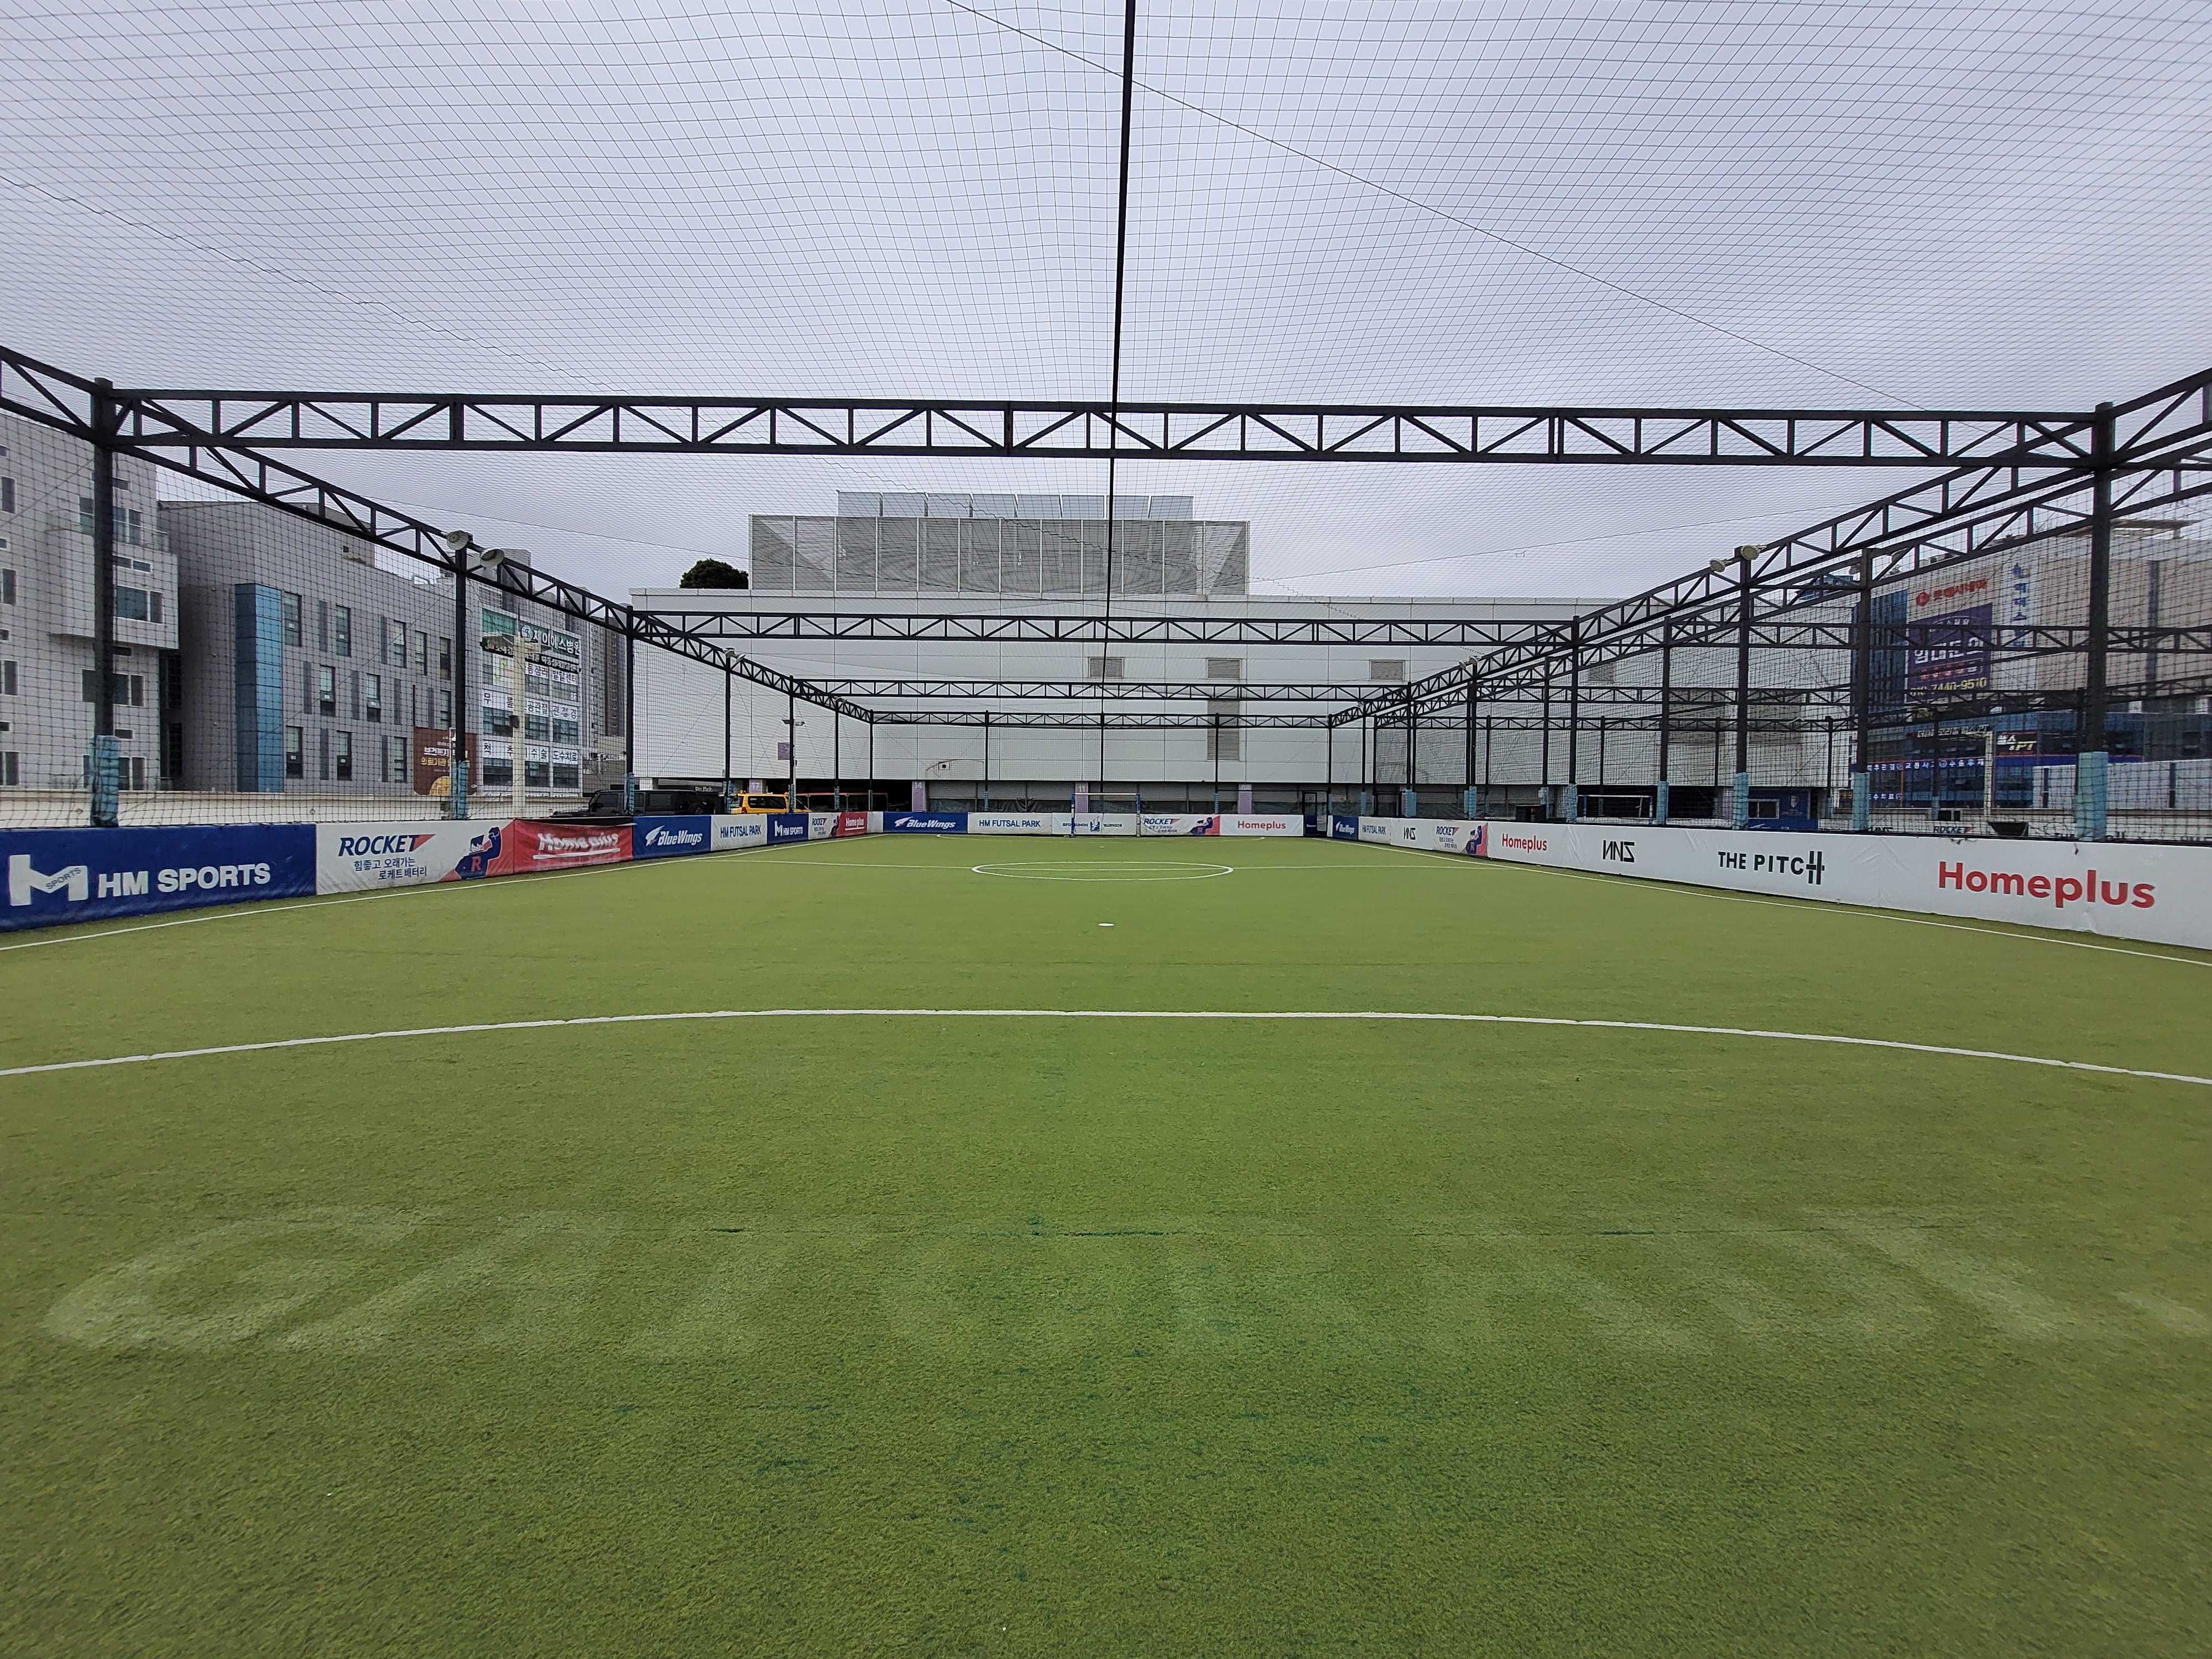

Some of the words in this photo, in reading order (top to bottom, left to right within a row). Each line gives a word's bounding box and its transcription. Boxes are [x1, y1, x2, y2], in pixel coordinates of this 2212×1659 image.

[721, 826, 729, 838] HM
[730, 826, 748, 837] FUTSAL
[749, 825, 761, 835] PARK
[1238, 821, 1286, 831] Homeplus
[1436, 826, 1455, 836] ROCKET
[338, 834, 420, 857] ROCKET
[1502, 833, 1547, 854] Homeplus
[354, 859, 381, 872] 힘좋고
[384, 857, 415, 869] 오래가는
[378, 869, 403, 880] 로케트
[404, 867, 427, 878] 배터리
[1718, 851, 1746, 870] THE
[1754, 851, 1825, 885] PITCH
[46, 868, 82, 889] SPORTS
[98, 871, 149, 898] HM
[158, 863, 271, 893] SPORTS
[1939, 861, 2155, 908] Homeplus
